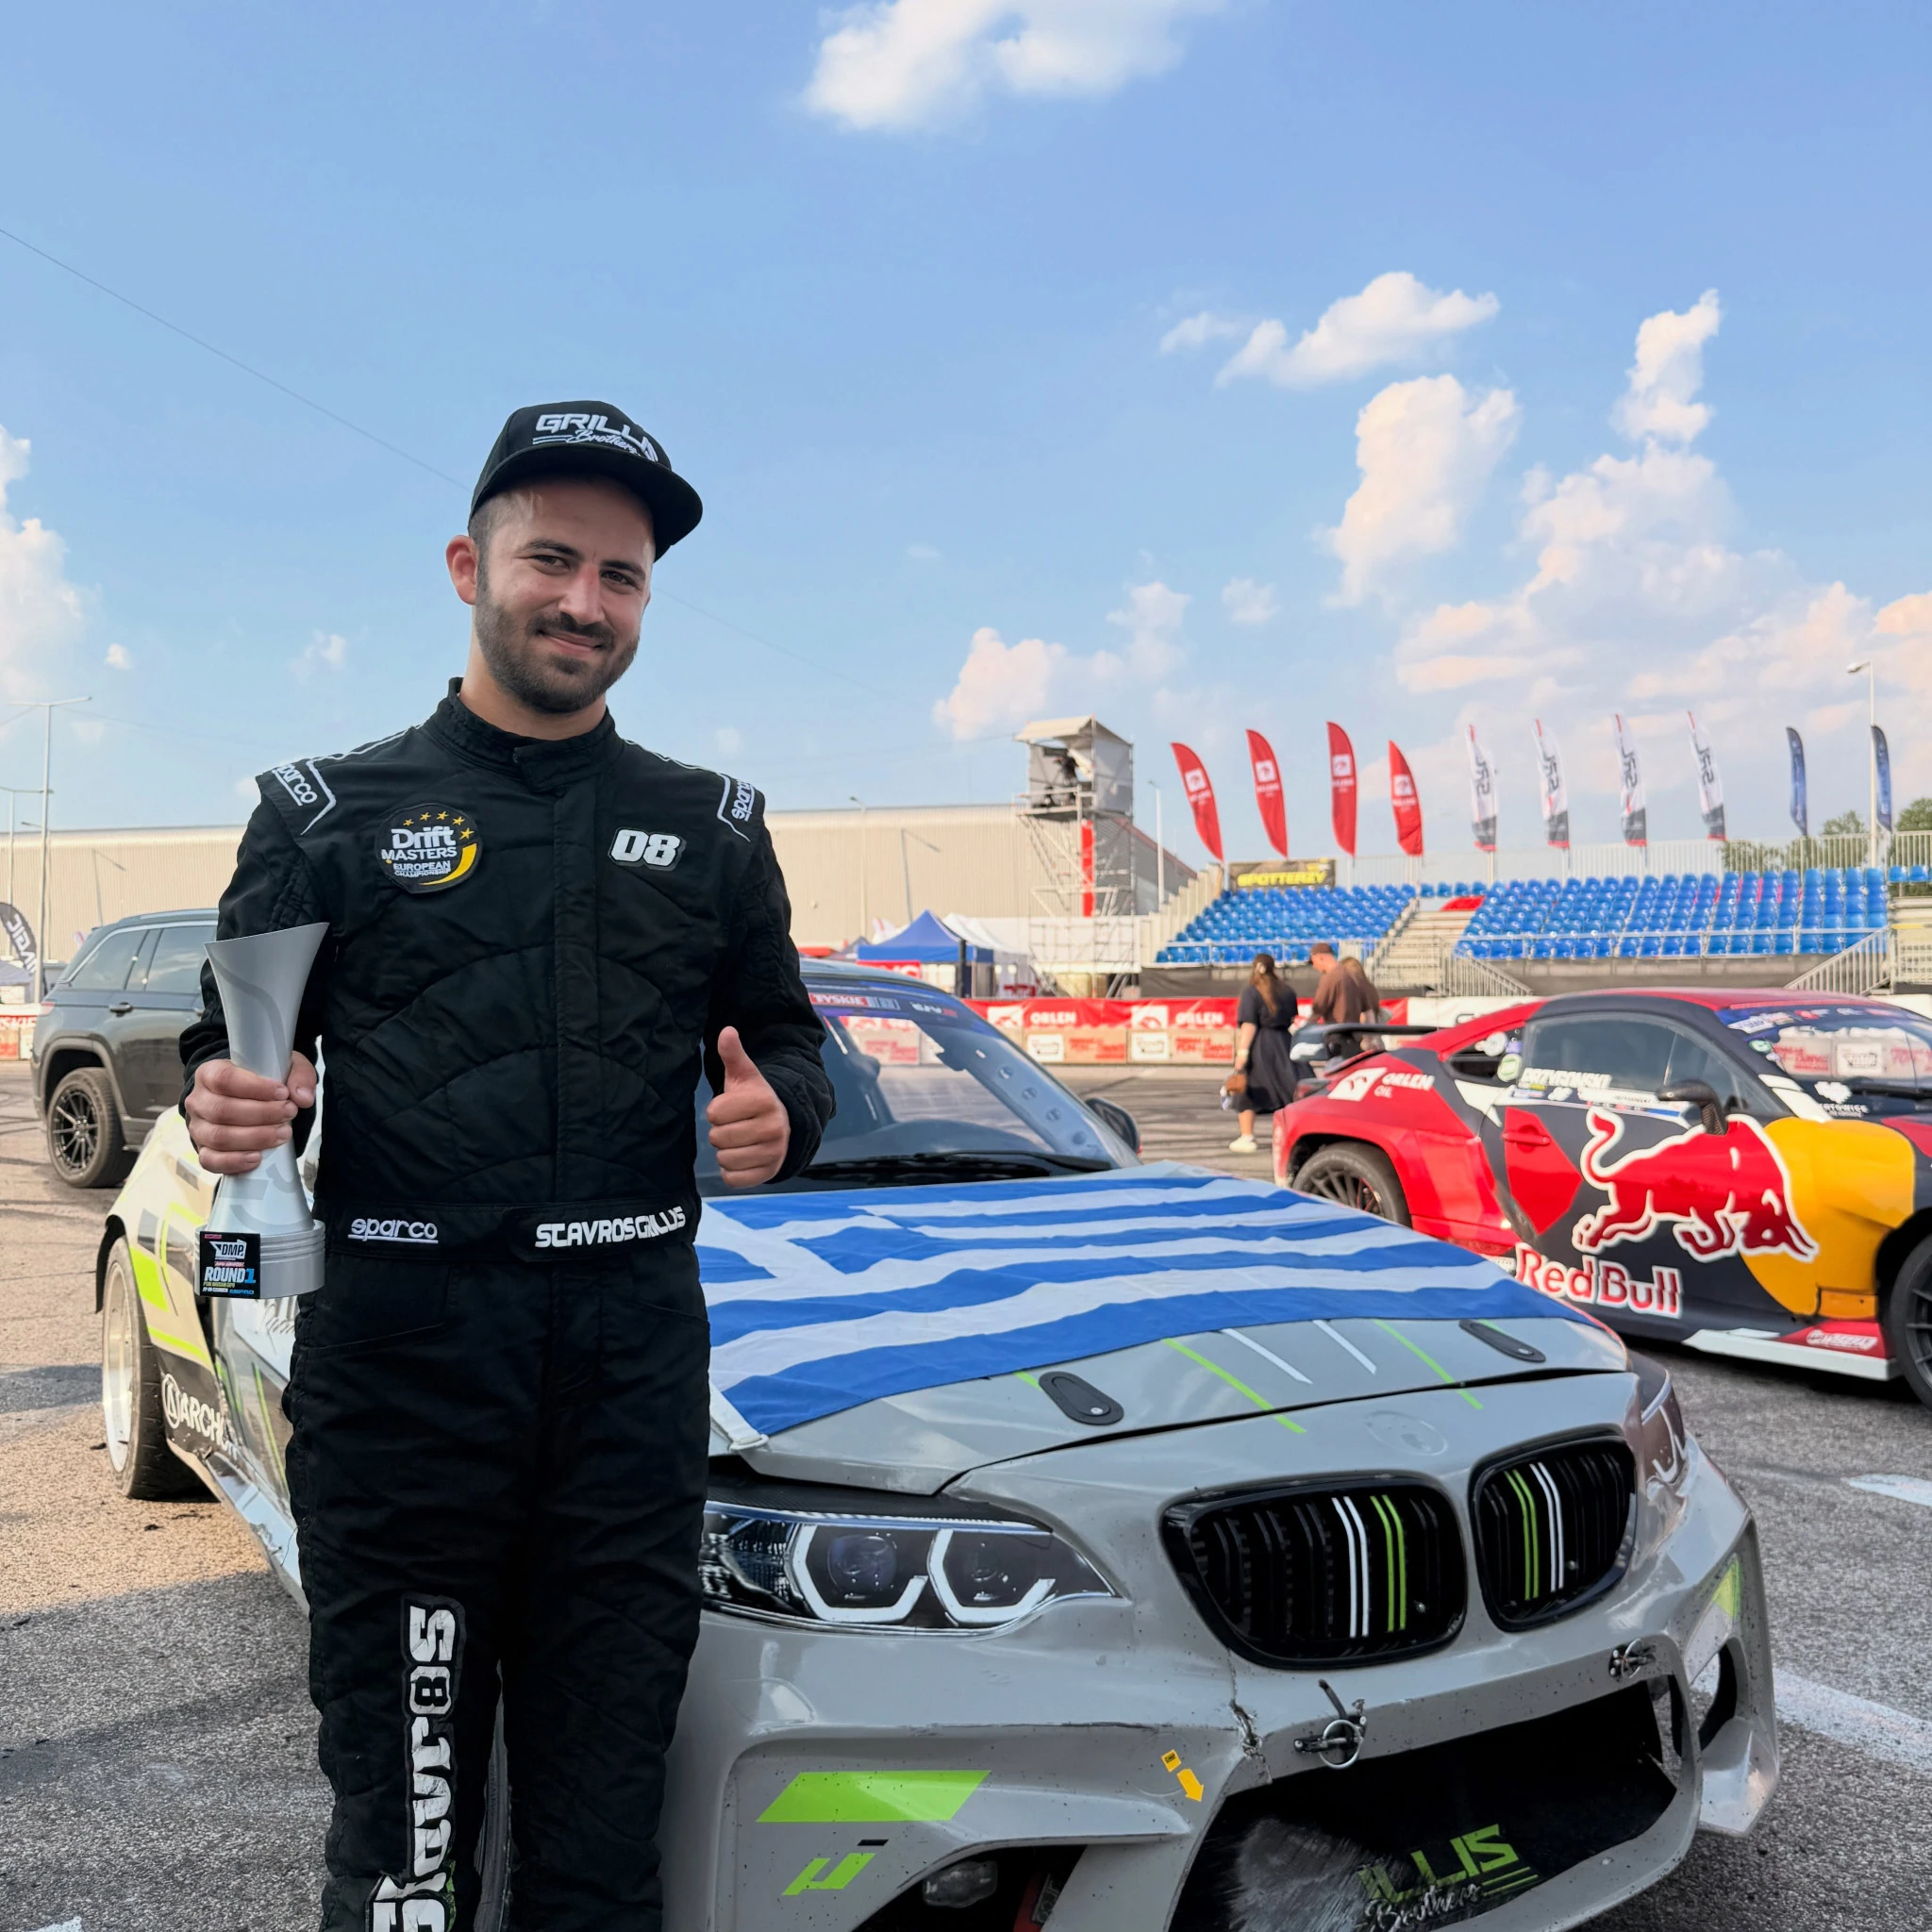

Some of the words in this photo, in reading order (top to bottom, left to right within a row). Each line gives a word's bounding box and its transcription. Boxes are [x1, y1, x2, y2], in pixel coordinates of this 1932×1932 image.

[272, 762, 319, 806] parco
[391, 826, 457, 849] Drift
[381, 846, 458, 861] MASTERS
[610, 828, 683, 868] 08
[392, 860, 452, 872] EUROPEAN
[1030, 1011, 1076, 1024] ORLEN
[1175, 1011, 1224, 1026] ORLEN
[1382, 1073, 1435, 1091] ORLEN
[1374, 1085, 1392, 1098] OIL
[347, 1217, 439, 1244] sparco
[204, 1267, 245, 1283] ROUND
[244, 1268, 257, 1284] 1
[1516, 1242, 1597, 1304] Red
[1598, 1260, 1682, 1318] Bull
